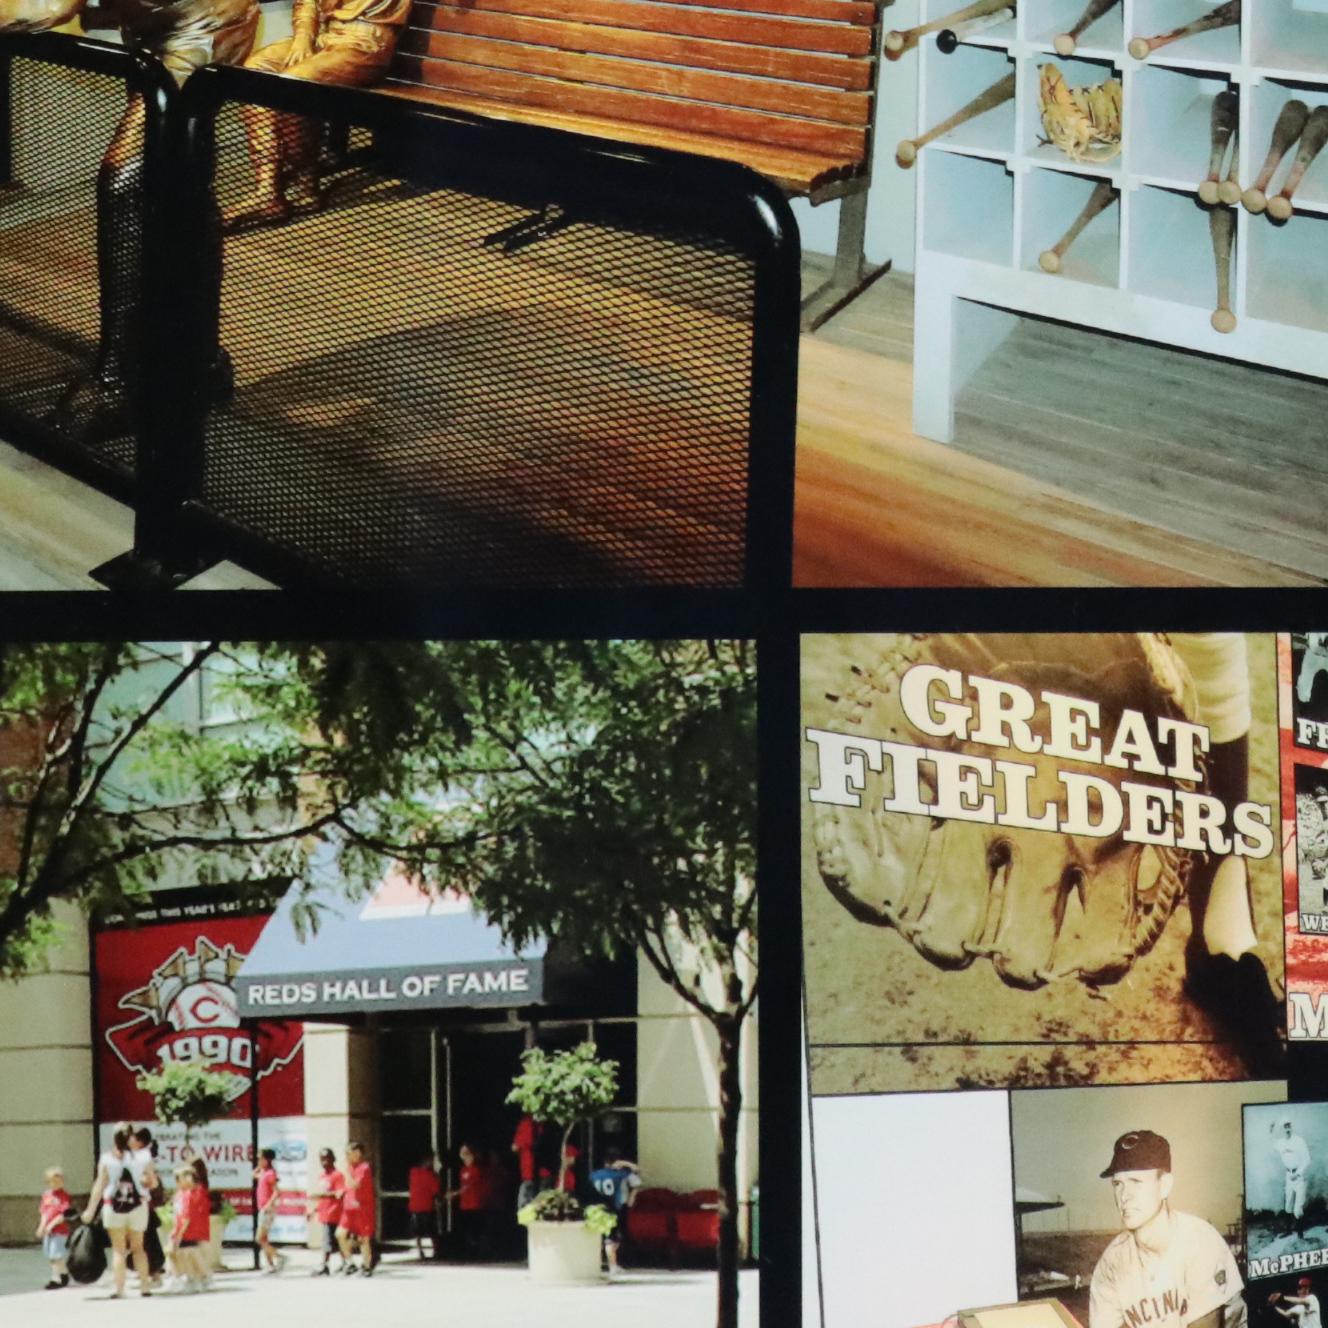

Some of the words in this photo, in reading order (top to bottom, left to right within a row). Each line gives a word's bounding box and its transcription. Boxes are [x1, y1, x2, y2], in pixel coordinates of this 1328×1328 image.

[900, 663, 1210, 783] GREAT
[805, 727, 1275, 860] FIELDERS
[248, 982, 316, 1006] REDS
[322, 977, 397, 1003] HALL
[402, 975, 441, 998] OF
[446, 969, 530, 994] FAME
[156, 1034, 253, 1069] 1990
